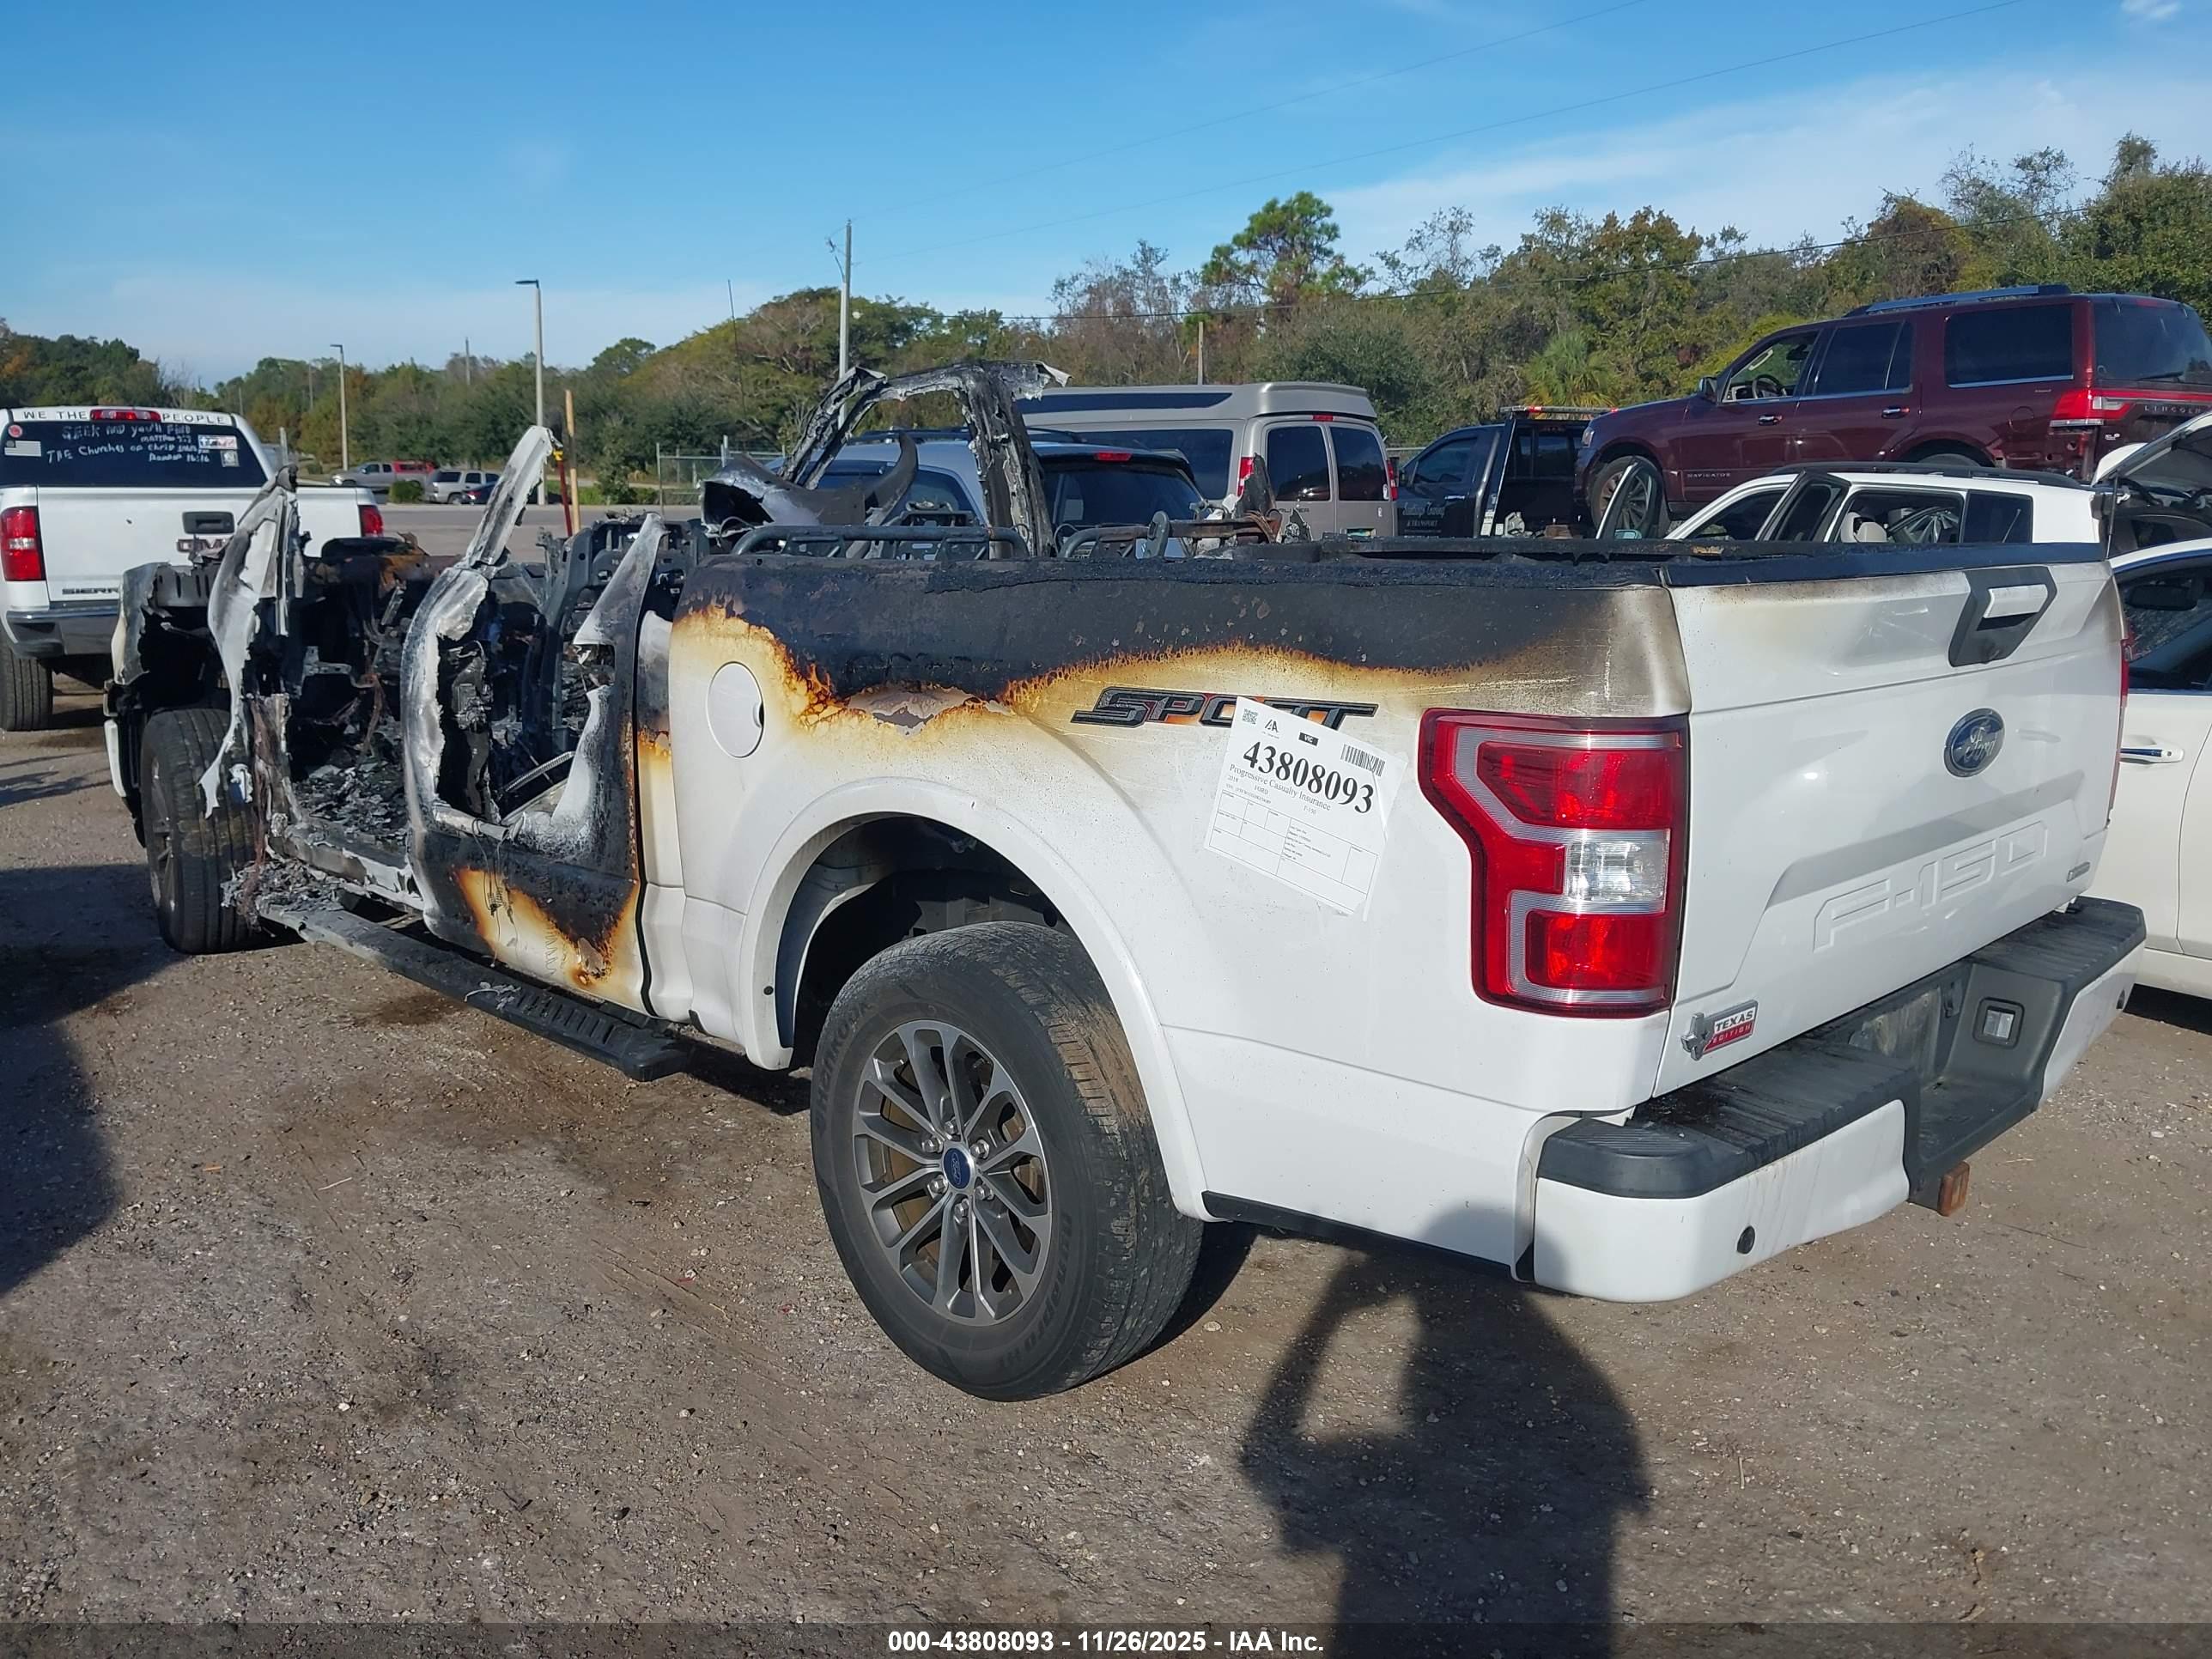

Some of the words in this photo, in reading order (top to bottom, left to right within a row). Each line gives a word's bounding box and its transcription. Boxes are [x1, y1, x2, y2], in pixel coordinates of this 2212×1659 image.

[23, 410, 47, 419] WE
[56, 410, 88, 419] THE
[162, 413, 224, 424] PEOPLE
[2144, 404, 2201, 414] LINCOLN
[1229, 763, 1268, 785] Progressive
[1269, 779, 1297, 798] Casualty
[1298, 791, 1331, 811] Insurance
[1243, 741, 1374, 814] 43808093
[1812, 820, 2048, 953] F-150
[1716, 1010, 1754, 1032] TEXAS
[1712, 1024, 1752, 1044] EDITION
